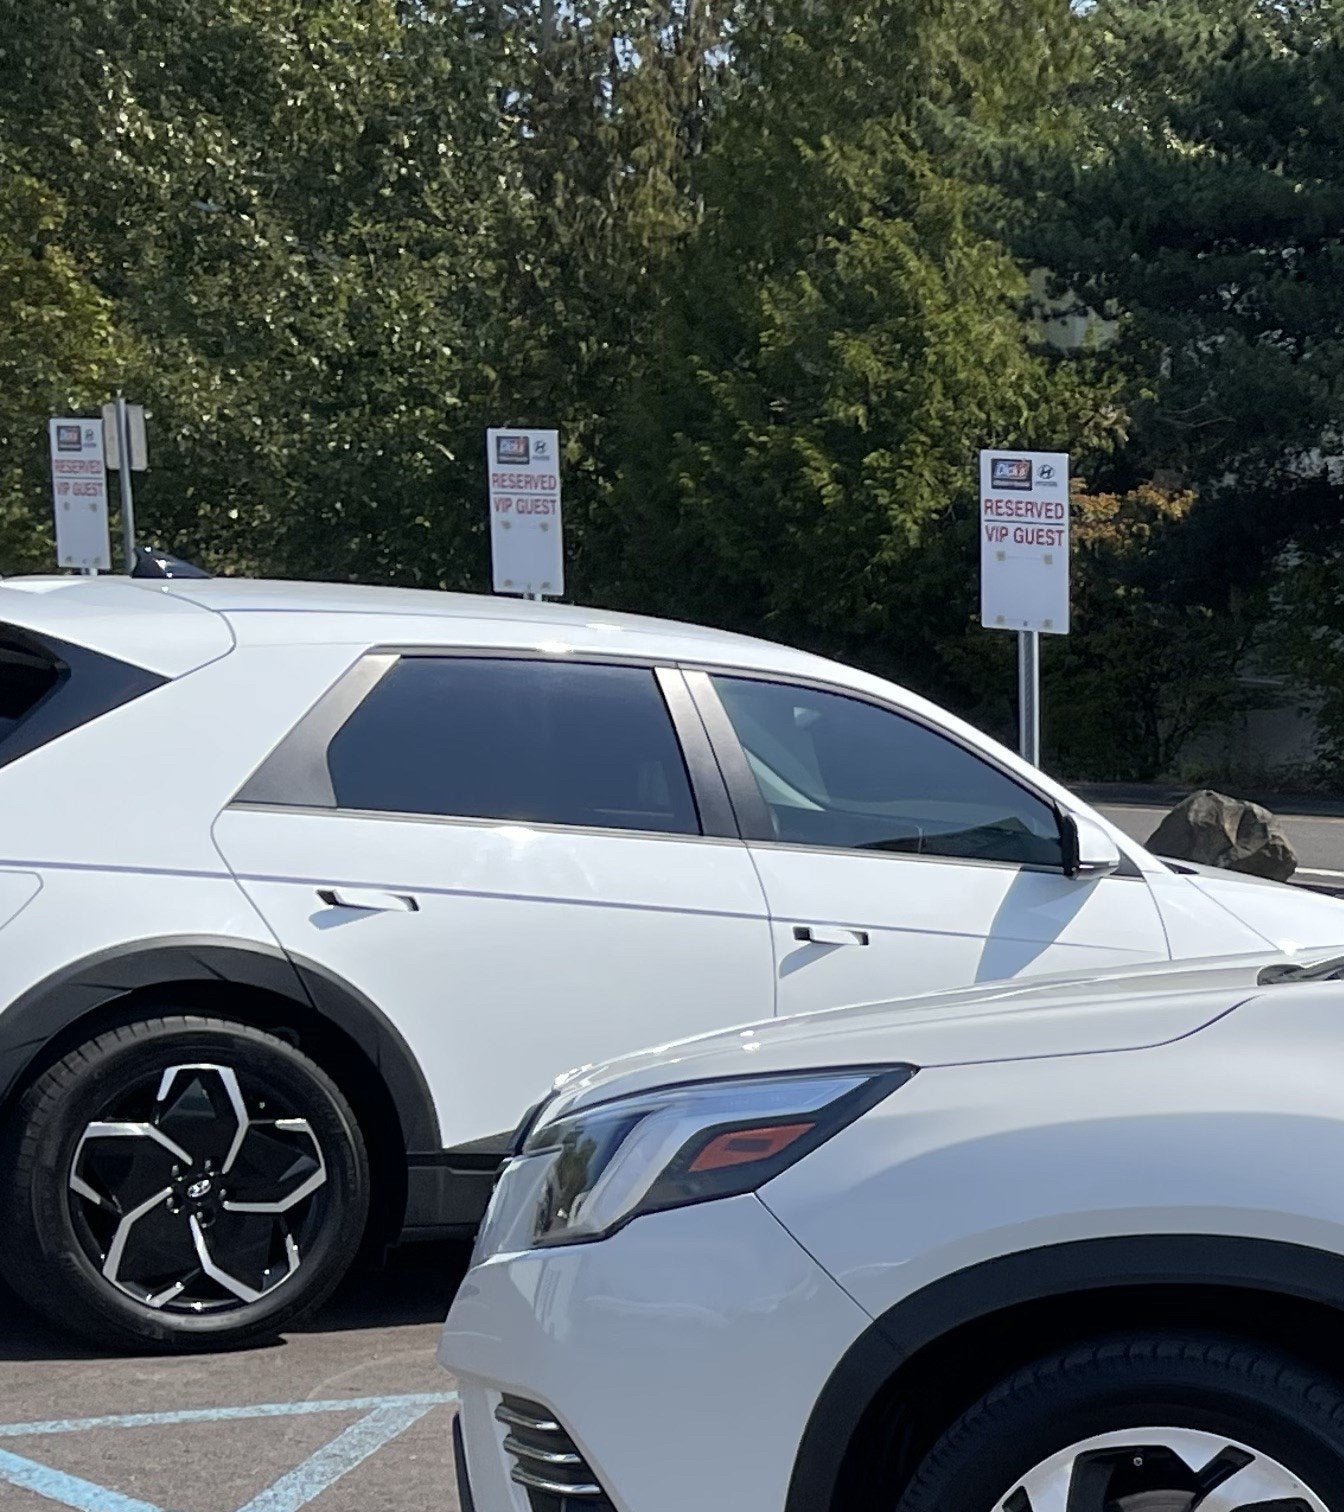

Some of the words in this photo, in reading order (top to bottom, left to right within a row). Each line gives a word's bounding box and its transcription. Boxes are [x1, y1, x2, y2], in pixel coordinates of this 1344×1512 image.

[492, 473, 557, 490] RESERVED
[493, 497, 513, 512] VIP
[516, 498, 557, 515] GUEST
[984, 499, 1064, 519] RESERVED
[985, 525, 1008, 542] VIP
[1013, 527, 1065, 547] GUEST
